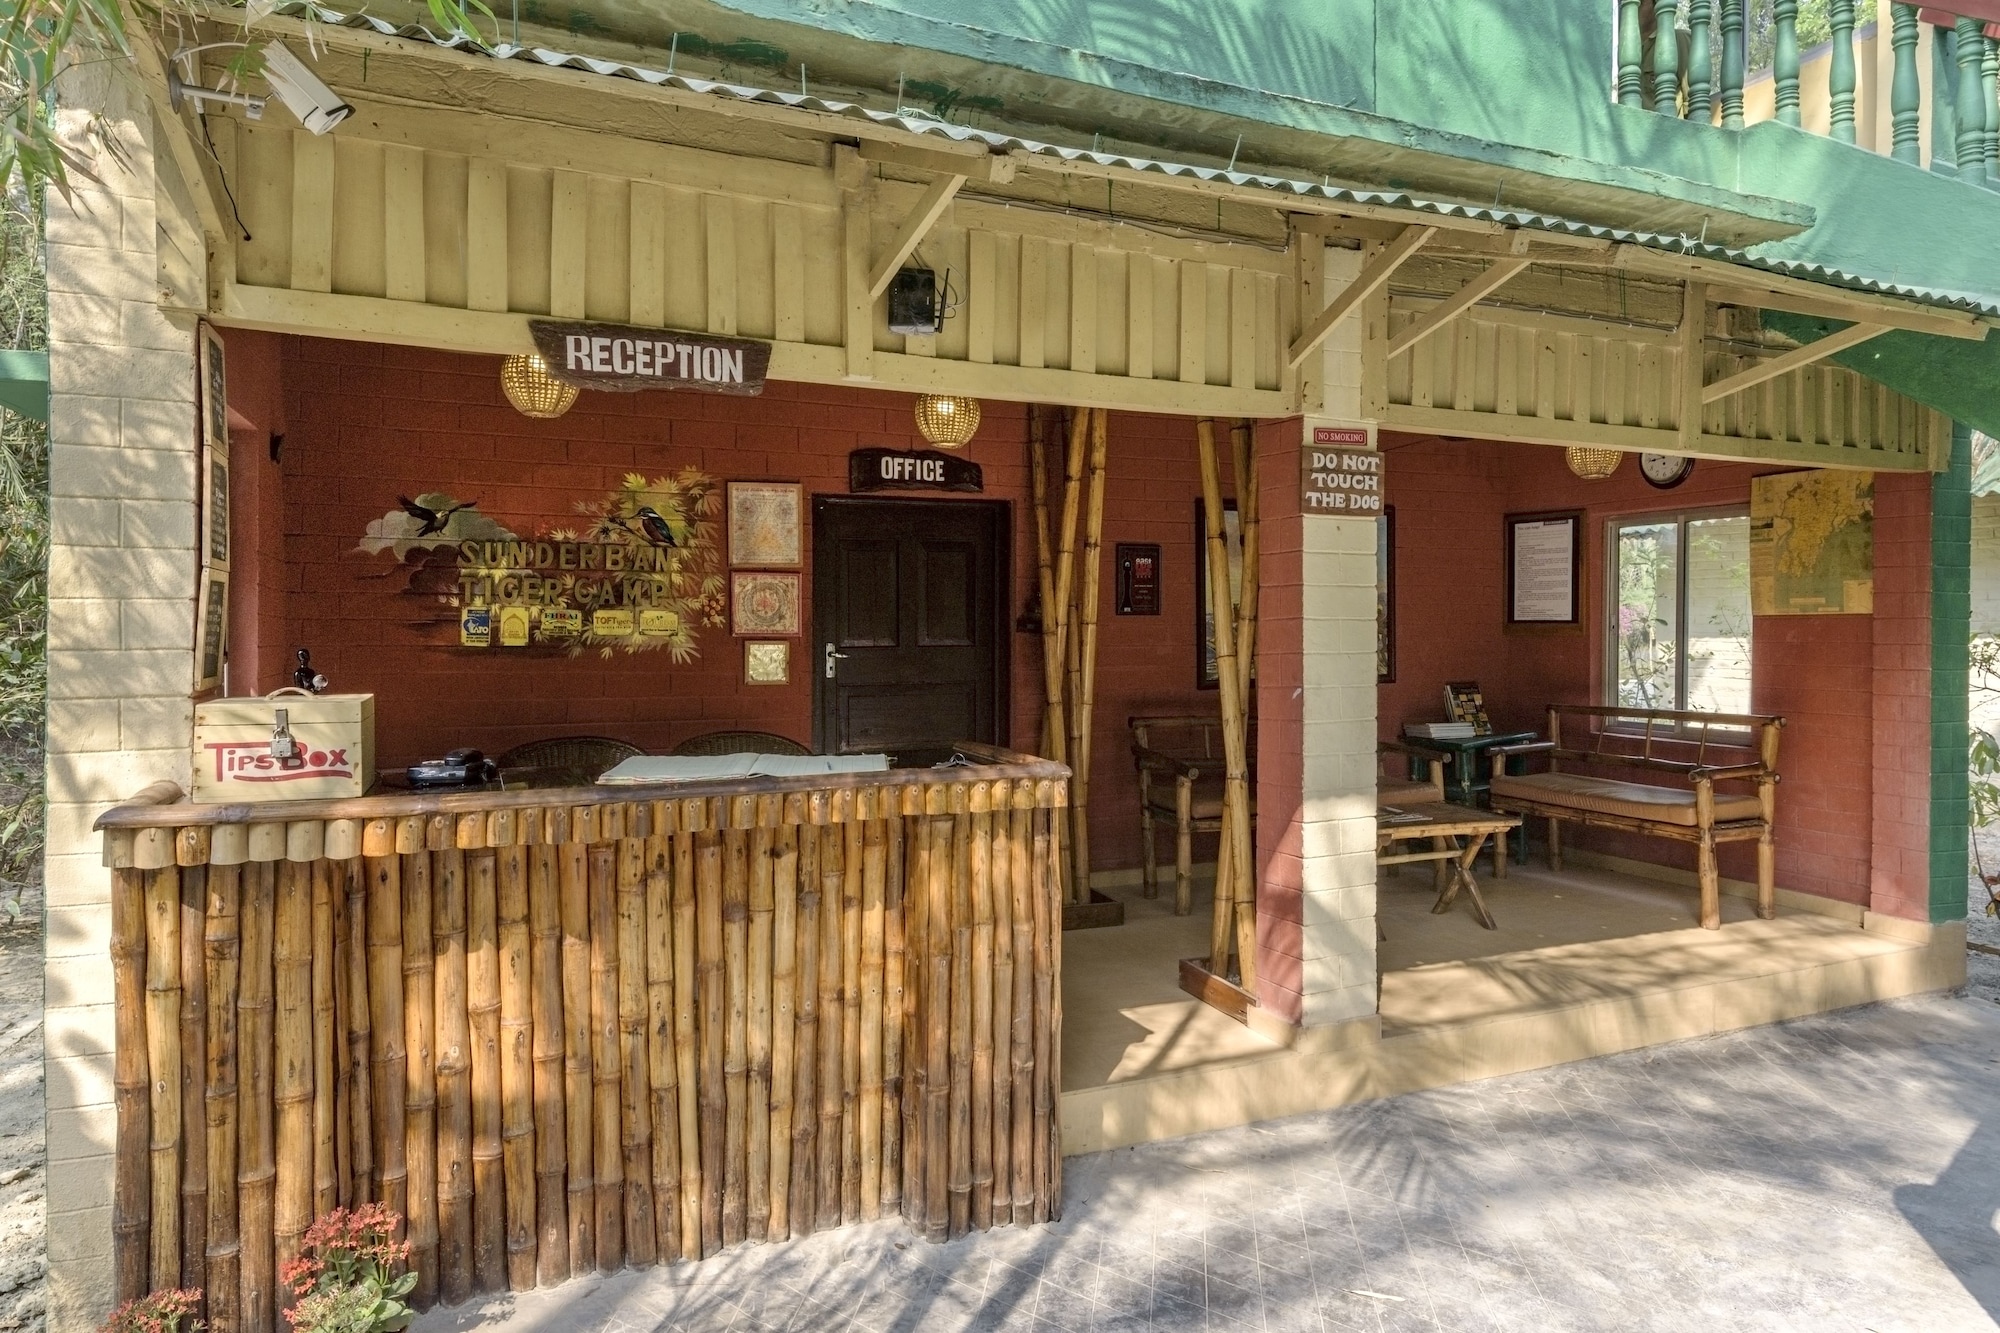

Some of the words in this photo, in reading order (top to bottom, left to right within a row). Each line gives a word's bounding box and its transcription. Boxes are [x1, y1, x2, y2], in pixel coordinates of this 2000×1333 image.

[566, 335, 743, 383] RECEPTION
[1318, 432, 1329, 440] NO
[1330, 433, 1363, 442] SMOKING
[881, 456, 945, 481] OFFICE
[1312, 453, 1337, 469] DO
[1342, 454, 1380, 472] NOT
[1311, 473, 1378, 490] TOUCH
[1305, 491, 1346, 508] THE
[1350, 494, 1380, 510] DOG
[456, 540, 673, 572] SUNDERBAN
[458, 575, 563, 606] TIGER
[573, 578, 670, 606] CAMP
